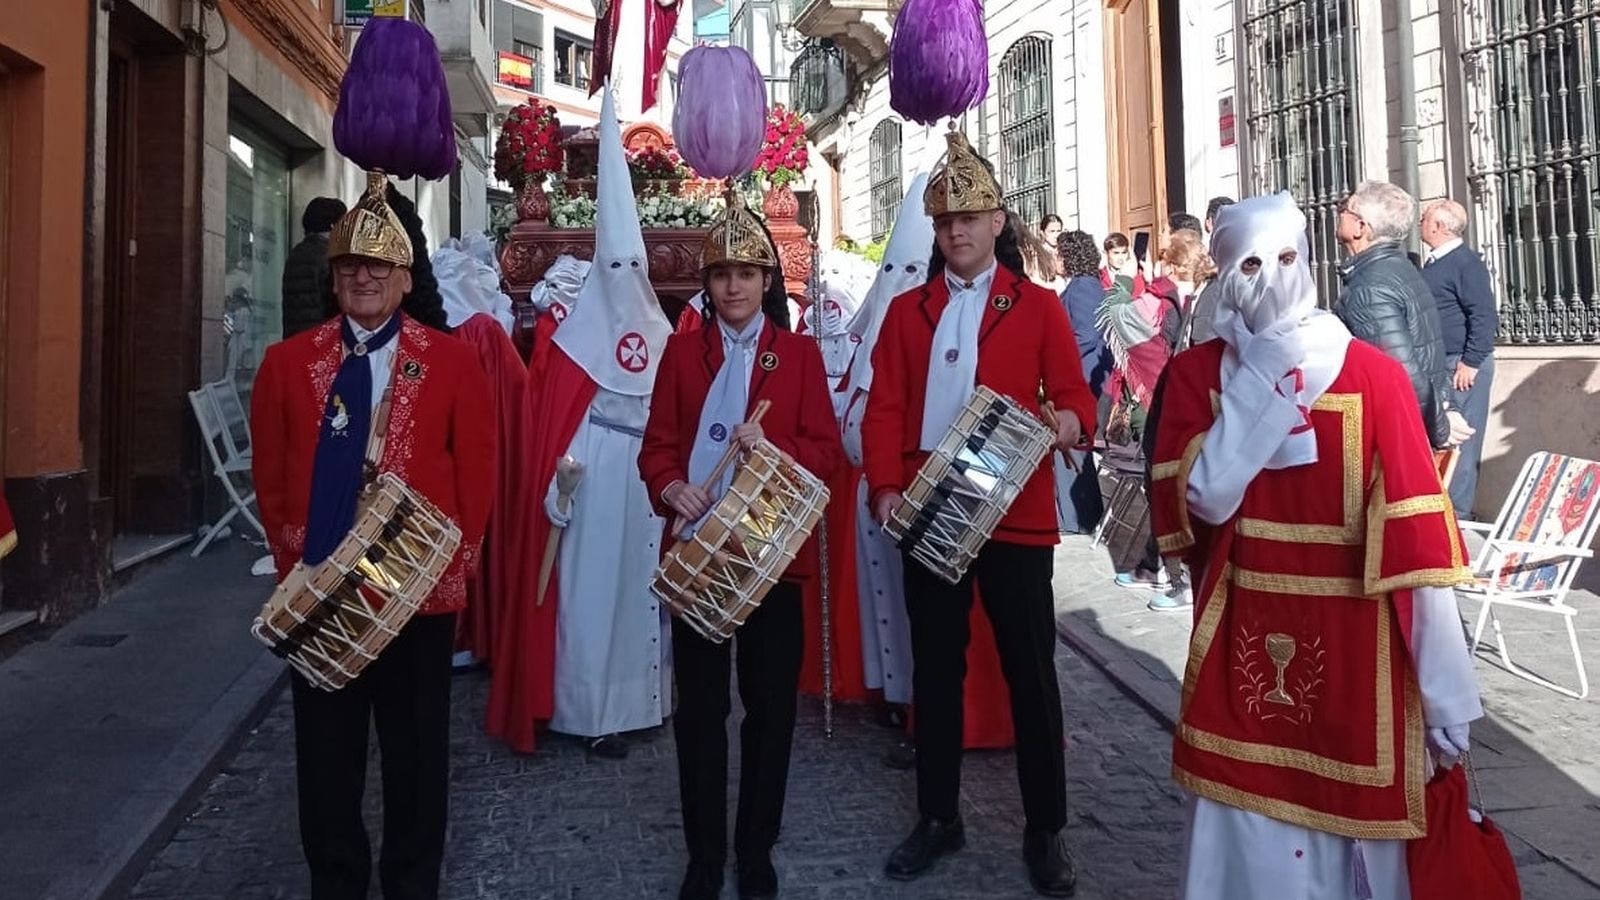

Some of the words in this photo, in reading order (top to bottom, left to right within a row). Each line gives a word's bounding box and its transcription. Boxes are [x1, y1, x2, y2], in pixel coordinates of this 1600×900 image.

[998, 297, 1006, 307] 2
[765, 355, 773, 367] 2
[408, 363, 417, 374] 2
[713, 426, 722, 439] 2
